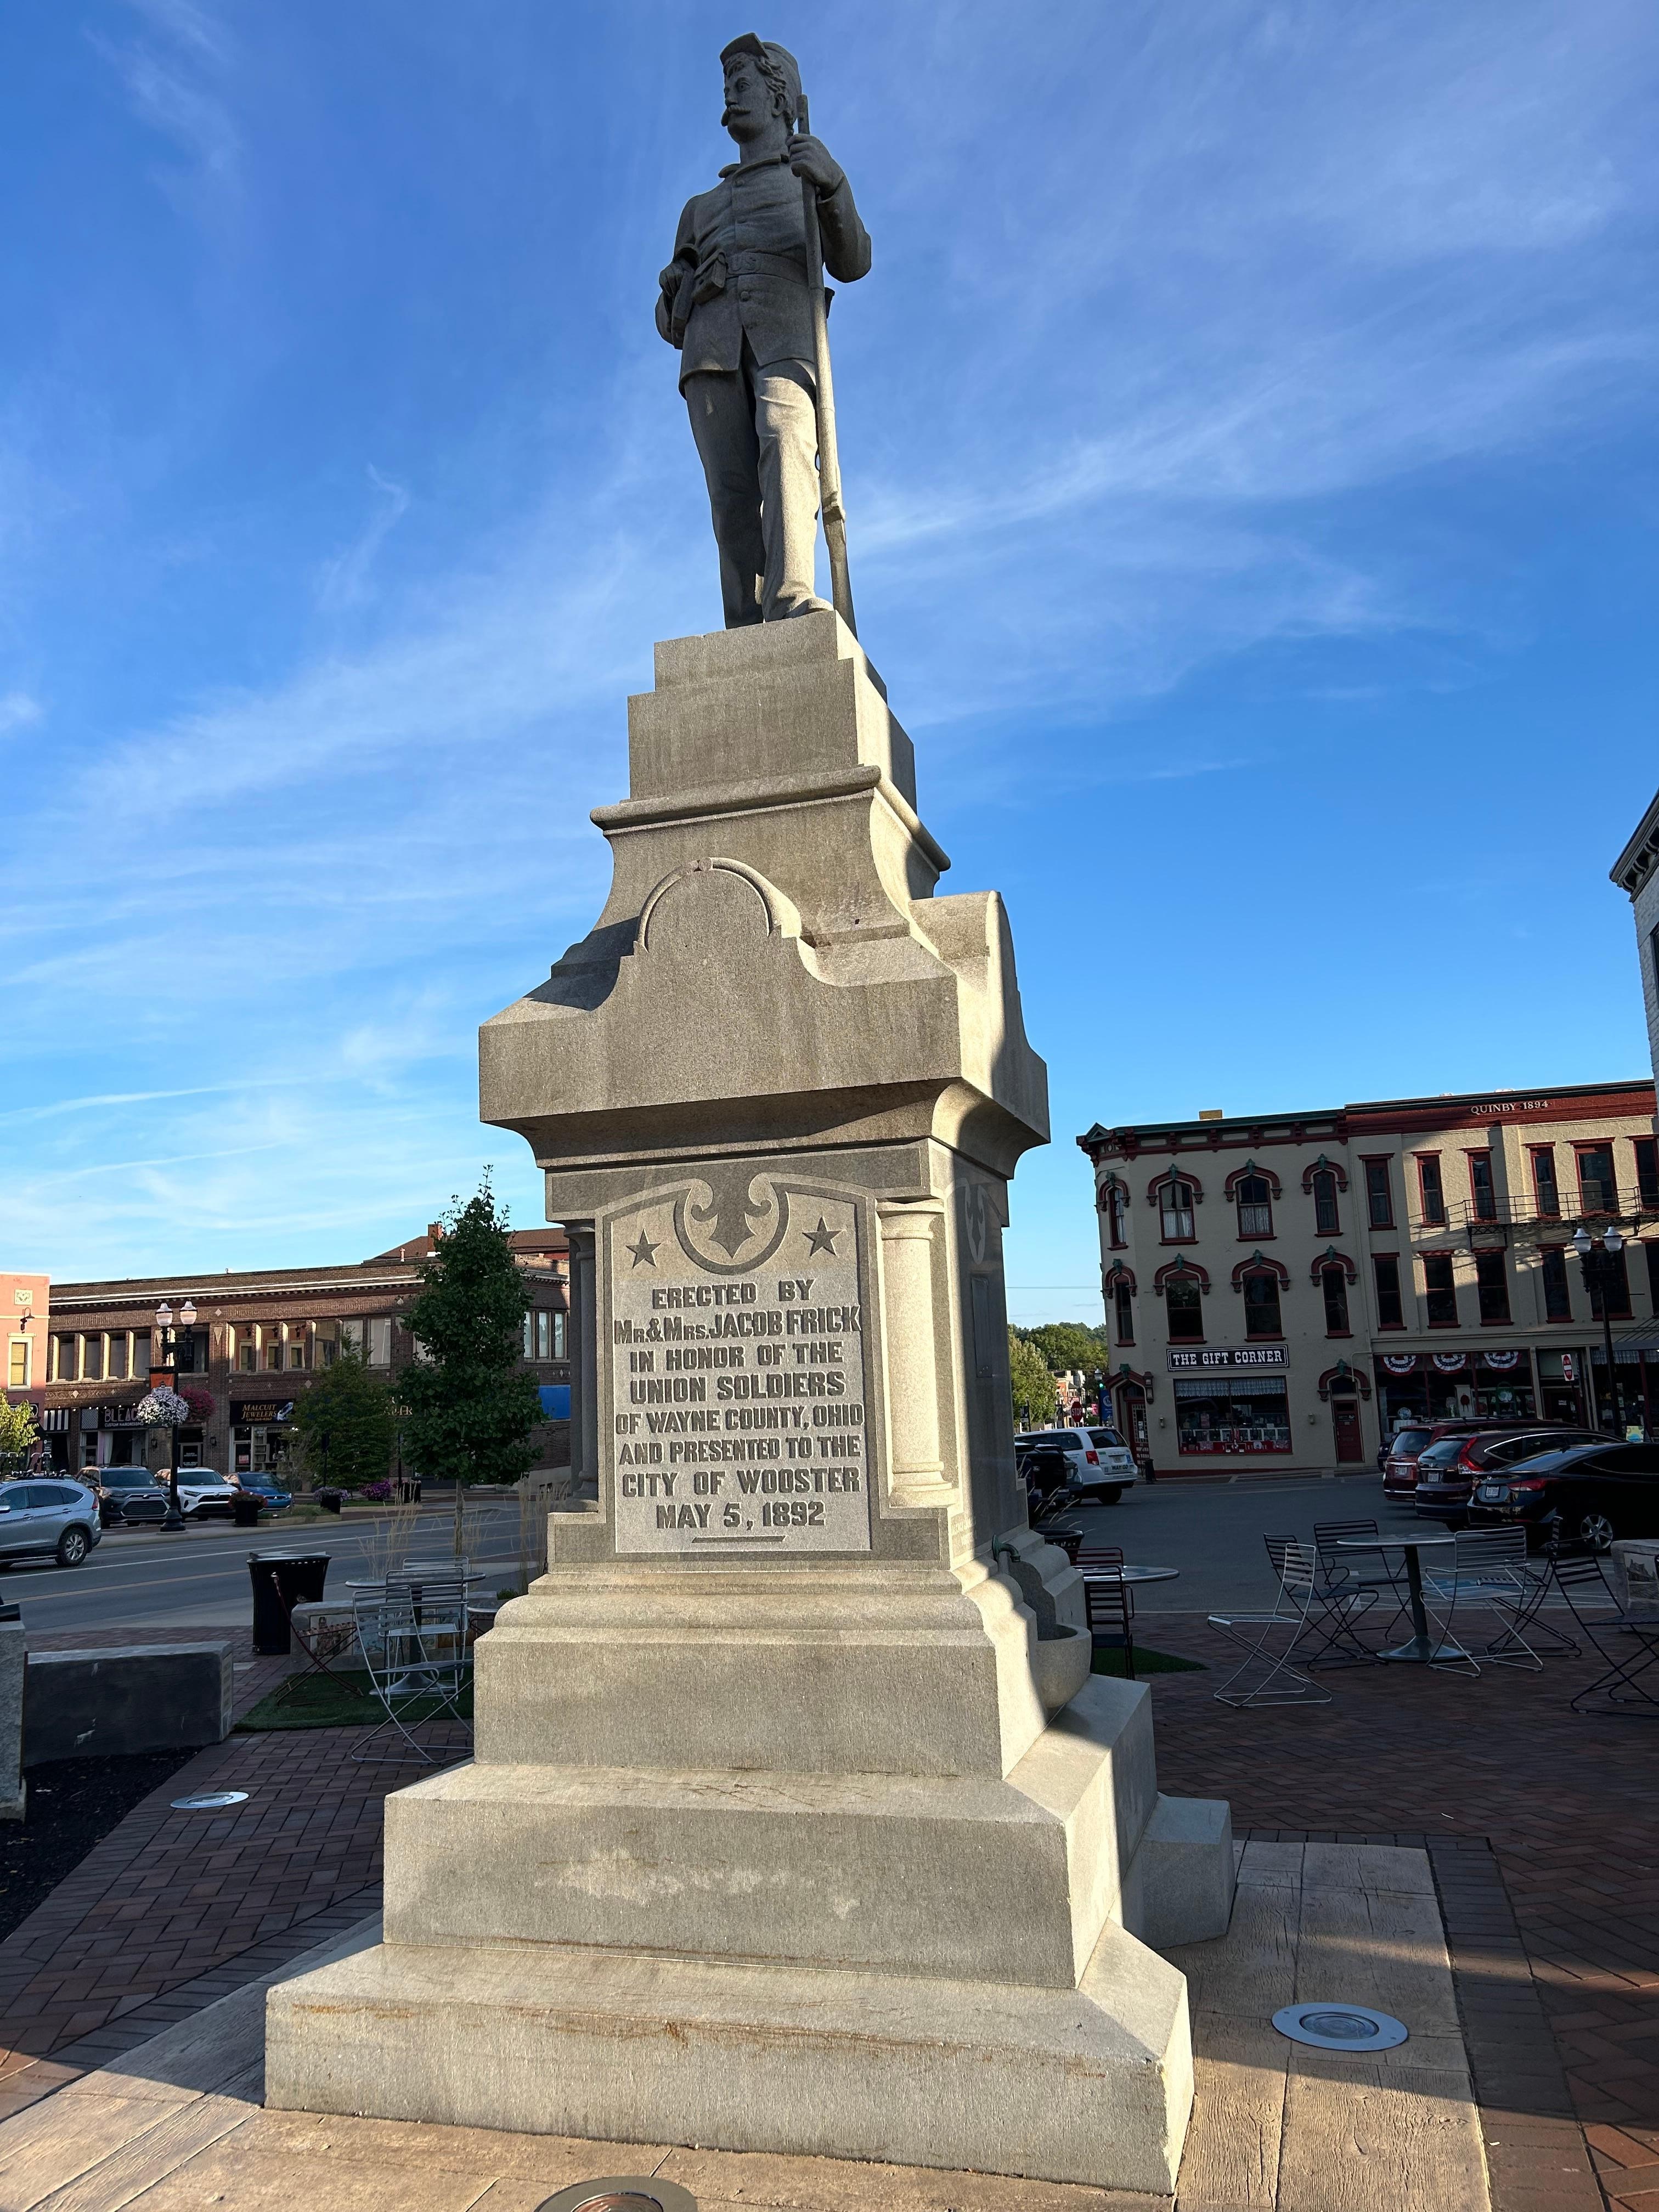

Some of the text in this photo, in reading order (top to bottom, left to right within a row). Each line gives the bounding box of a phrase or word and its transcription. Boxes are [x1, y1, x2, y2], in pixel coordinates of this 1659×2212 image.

[1470, 1100, 1549, 1115] QUINBY 1894
[652, 1278, 816, 1310] ERECTED BY
[709, 1309, 785, 1339] JACOB
[786, 1305, 862, 1335] FRICK
[630, 1340, 844, 1372] IN HONOR OF THE
[1173, 1350, 1283, 1365] THE GIFT CORNER
[630, 1370, 847, 1404] UNION SOLDIERS
[104, 1407, 139, 1423] BLEAC
[241, 1410, 277, 1419] JEWELERS
[616, 1403, 865, 1435] OF WAYNE COUNTY, OHIO
[1071, 1408, 1082, 1417] STOP
[619, 1434, 862, 1465] AND PRESENTED TO THE
[622, 1465, 861, 1497] CITY OF WOOSTER
[656, 1502, 713, 1529] MAY
[762, 1499, 826, 1527] 1892
